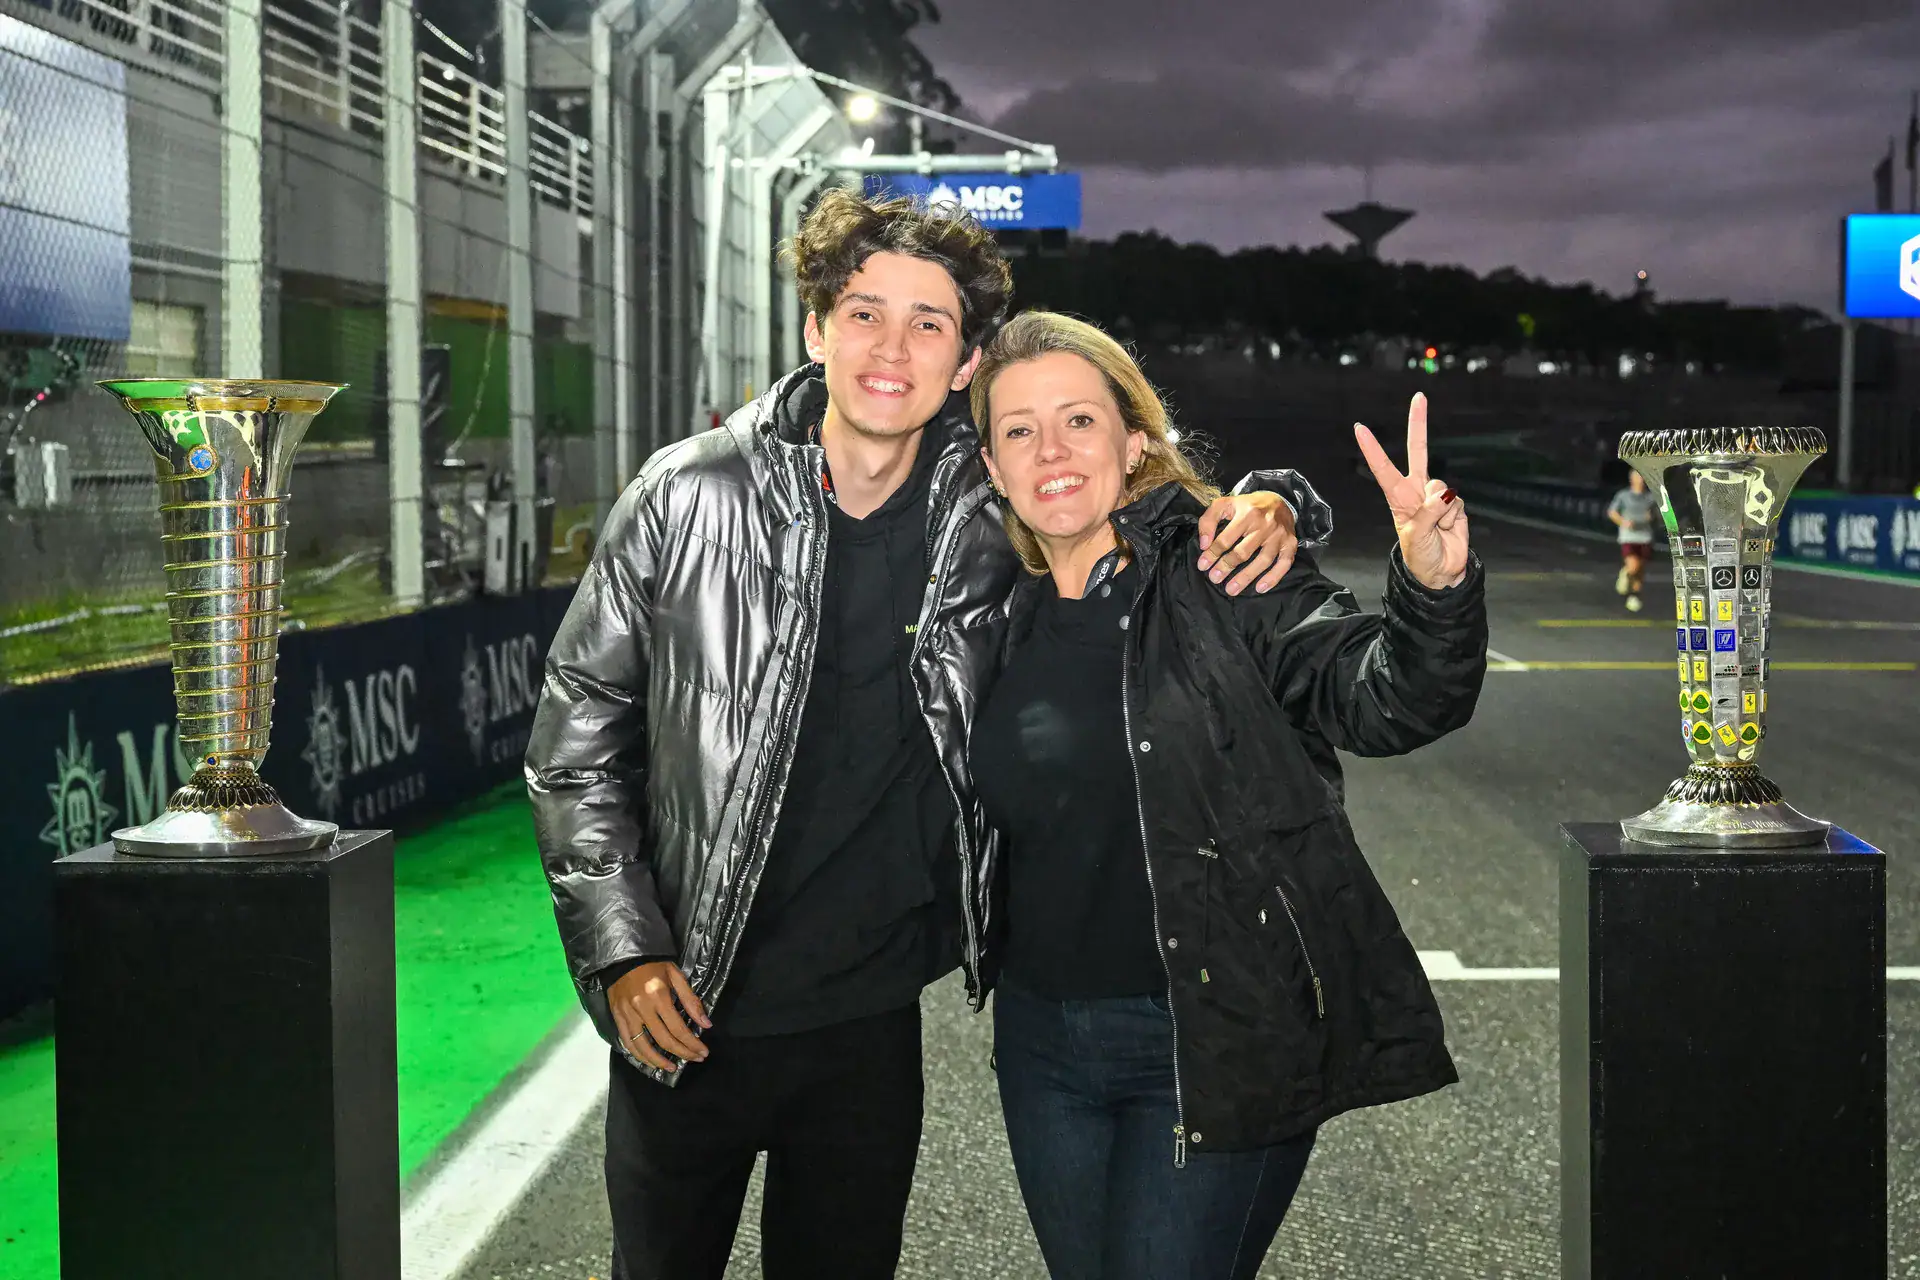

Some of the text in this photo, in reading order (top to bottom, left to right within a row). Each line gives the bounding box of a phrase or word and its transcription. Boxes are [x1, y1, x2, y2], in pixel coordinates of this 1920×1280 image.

[959, 186, 1023, 211] MSC
[345, 664, 420, 774] MSC
[484, 633, 540, 722] MSC
